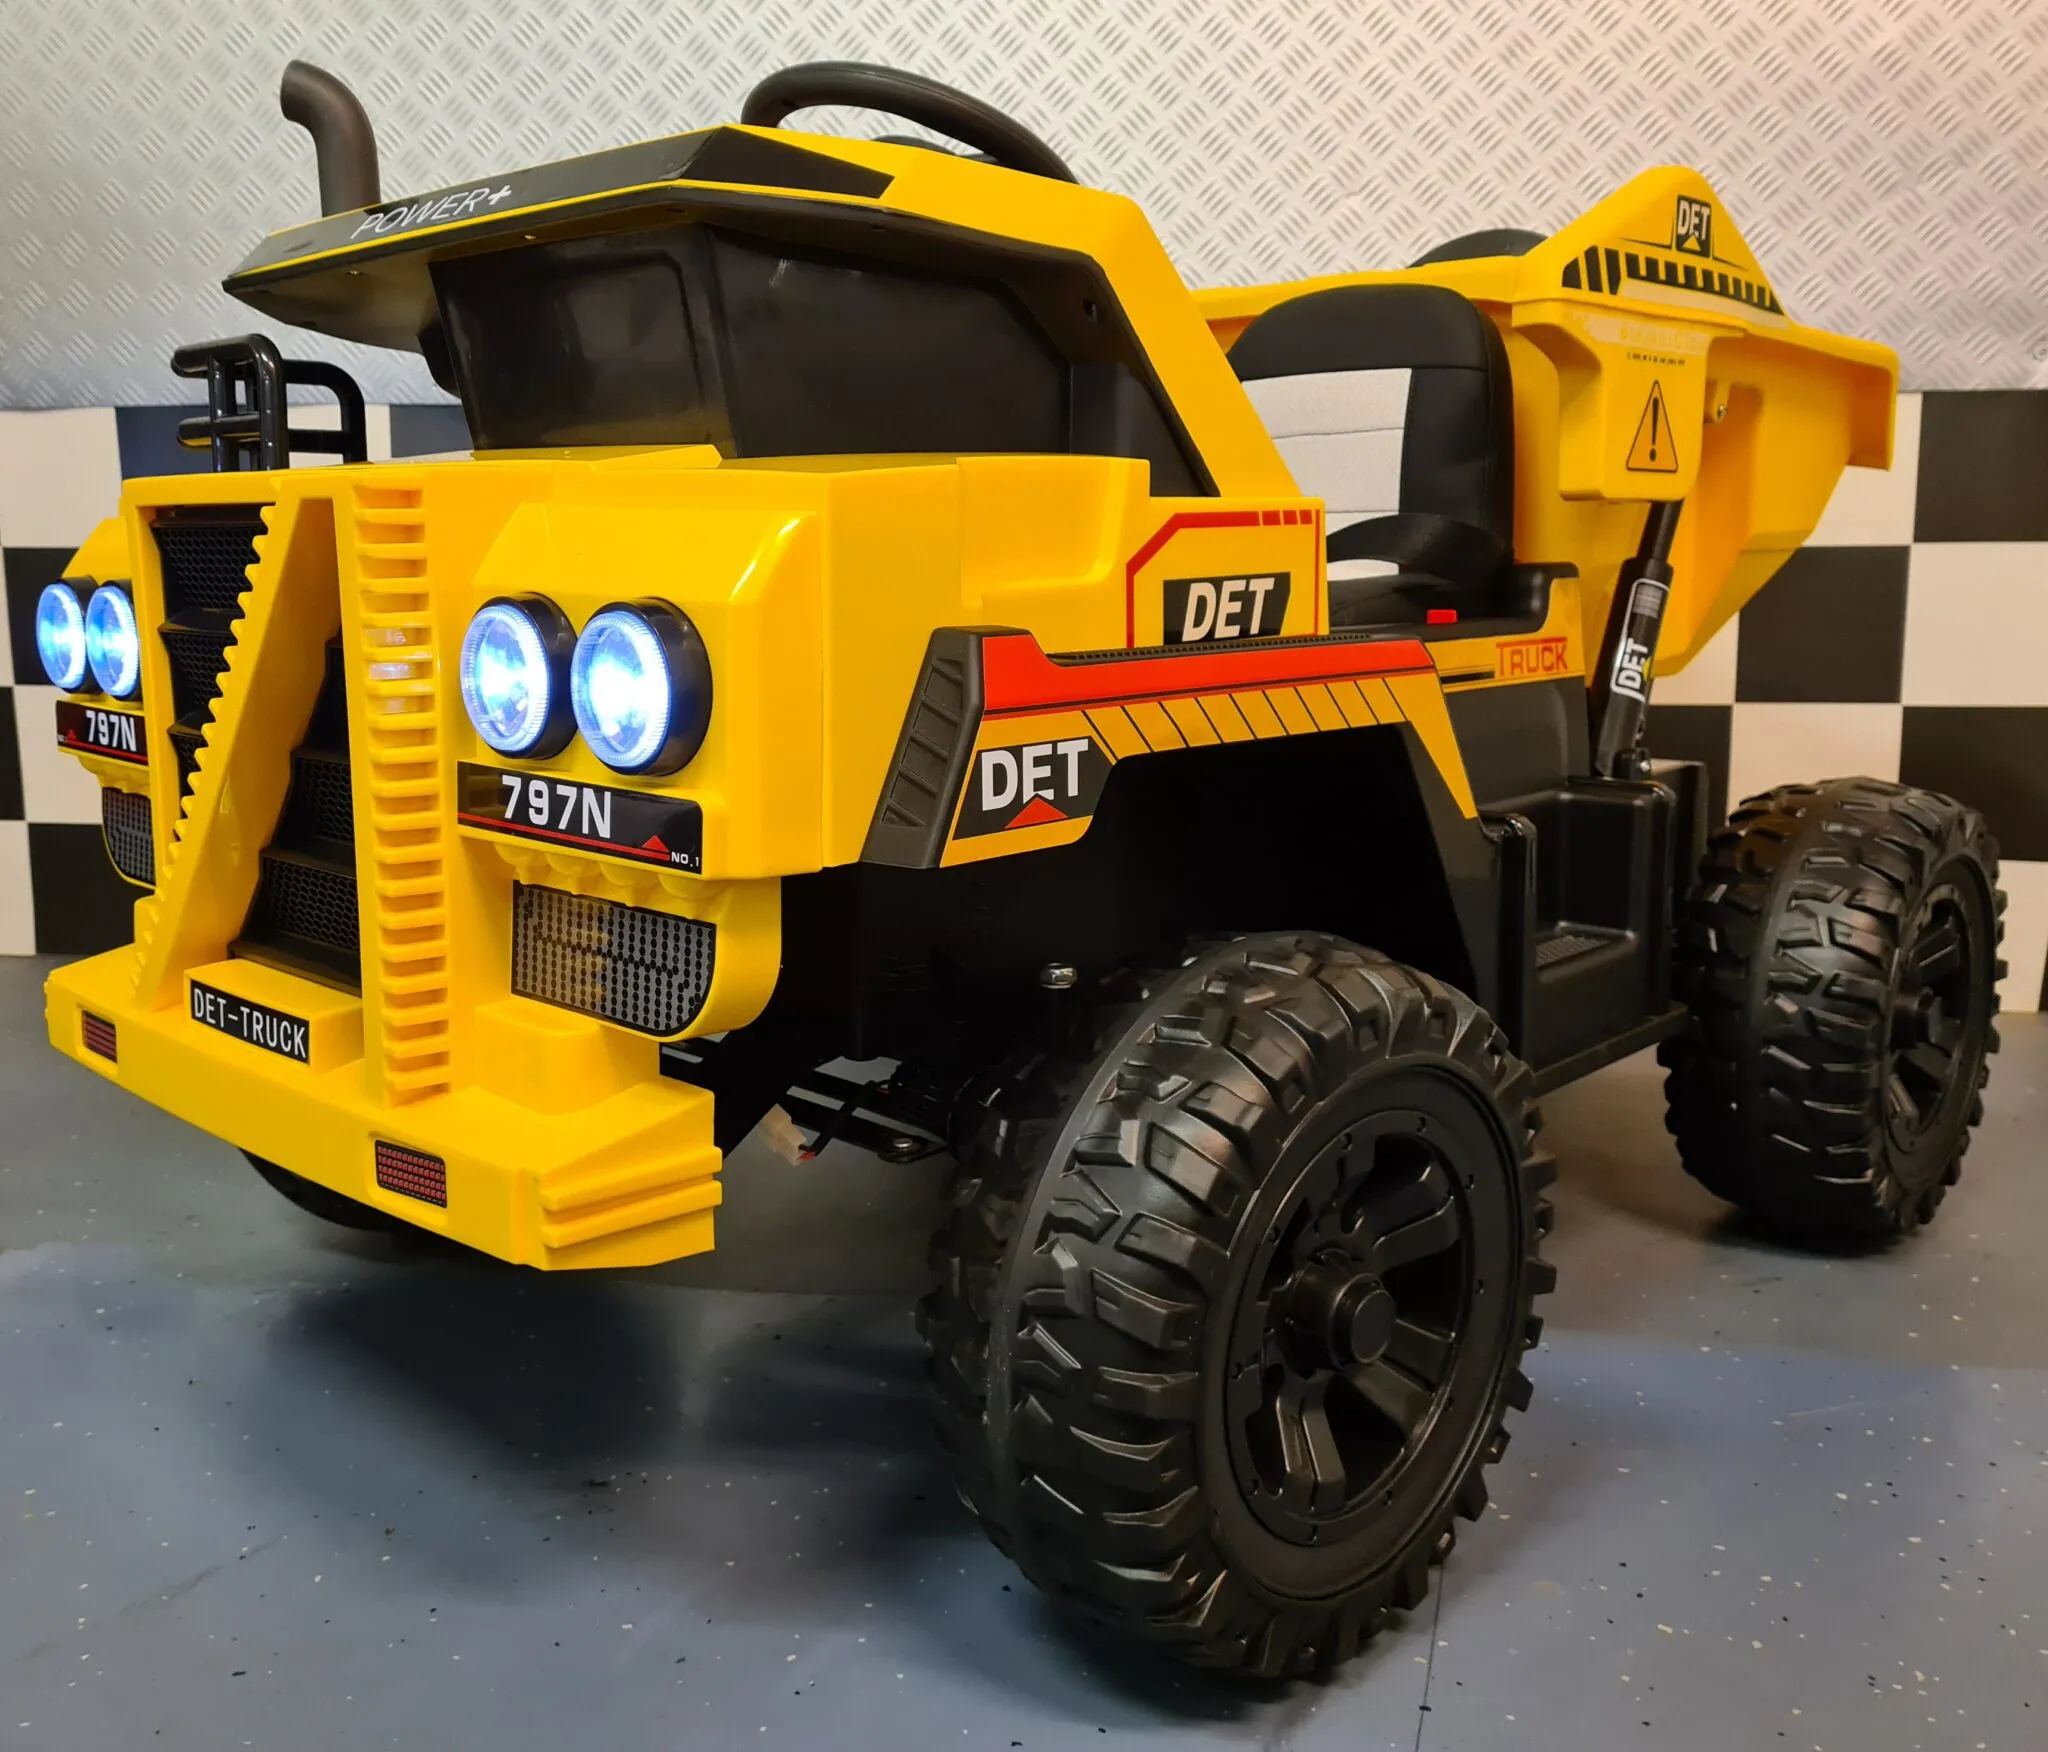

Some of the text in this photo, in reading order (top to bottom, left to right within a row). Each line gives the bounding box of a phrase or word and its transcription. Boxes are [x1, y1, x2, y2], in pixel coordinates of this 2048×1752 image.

[351, 185, 512, 239] POWER+
[1678, 200, 1711, 240] DET
[1182, 577, 1275, 642] DET
[1496, 637, 1568, 676] TRUCK
[1618, 637, 1649, 689] DET
[85, 710, 137, 752] 797N
[981, 738, 1089, 812] DET
[502, 774, 611, 839] 797N
[194, 987, 306, 1058] DET-TRUCK
